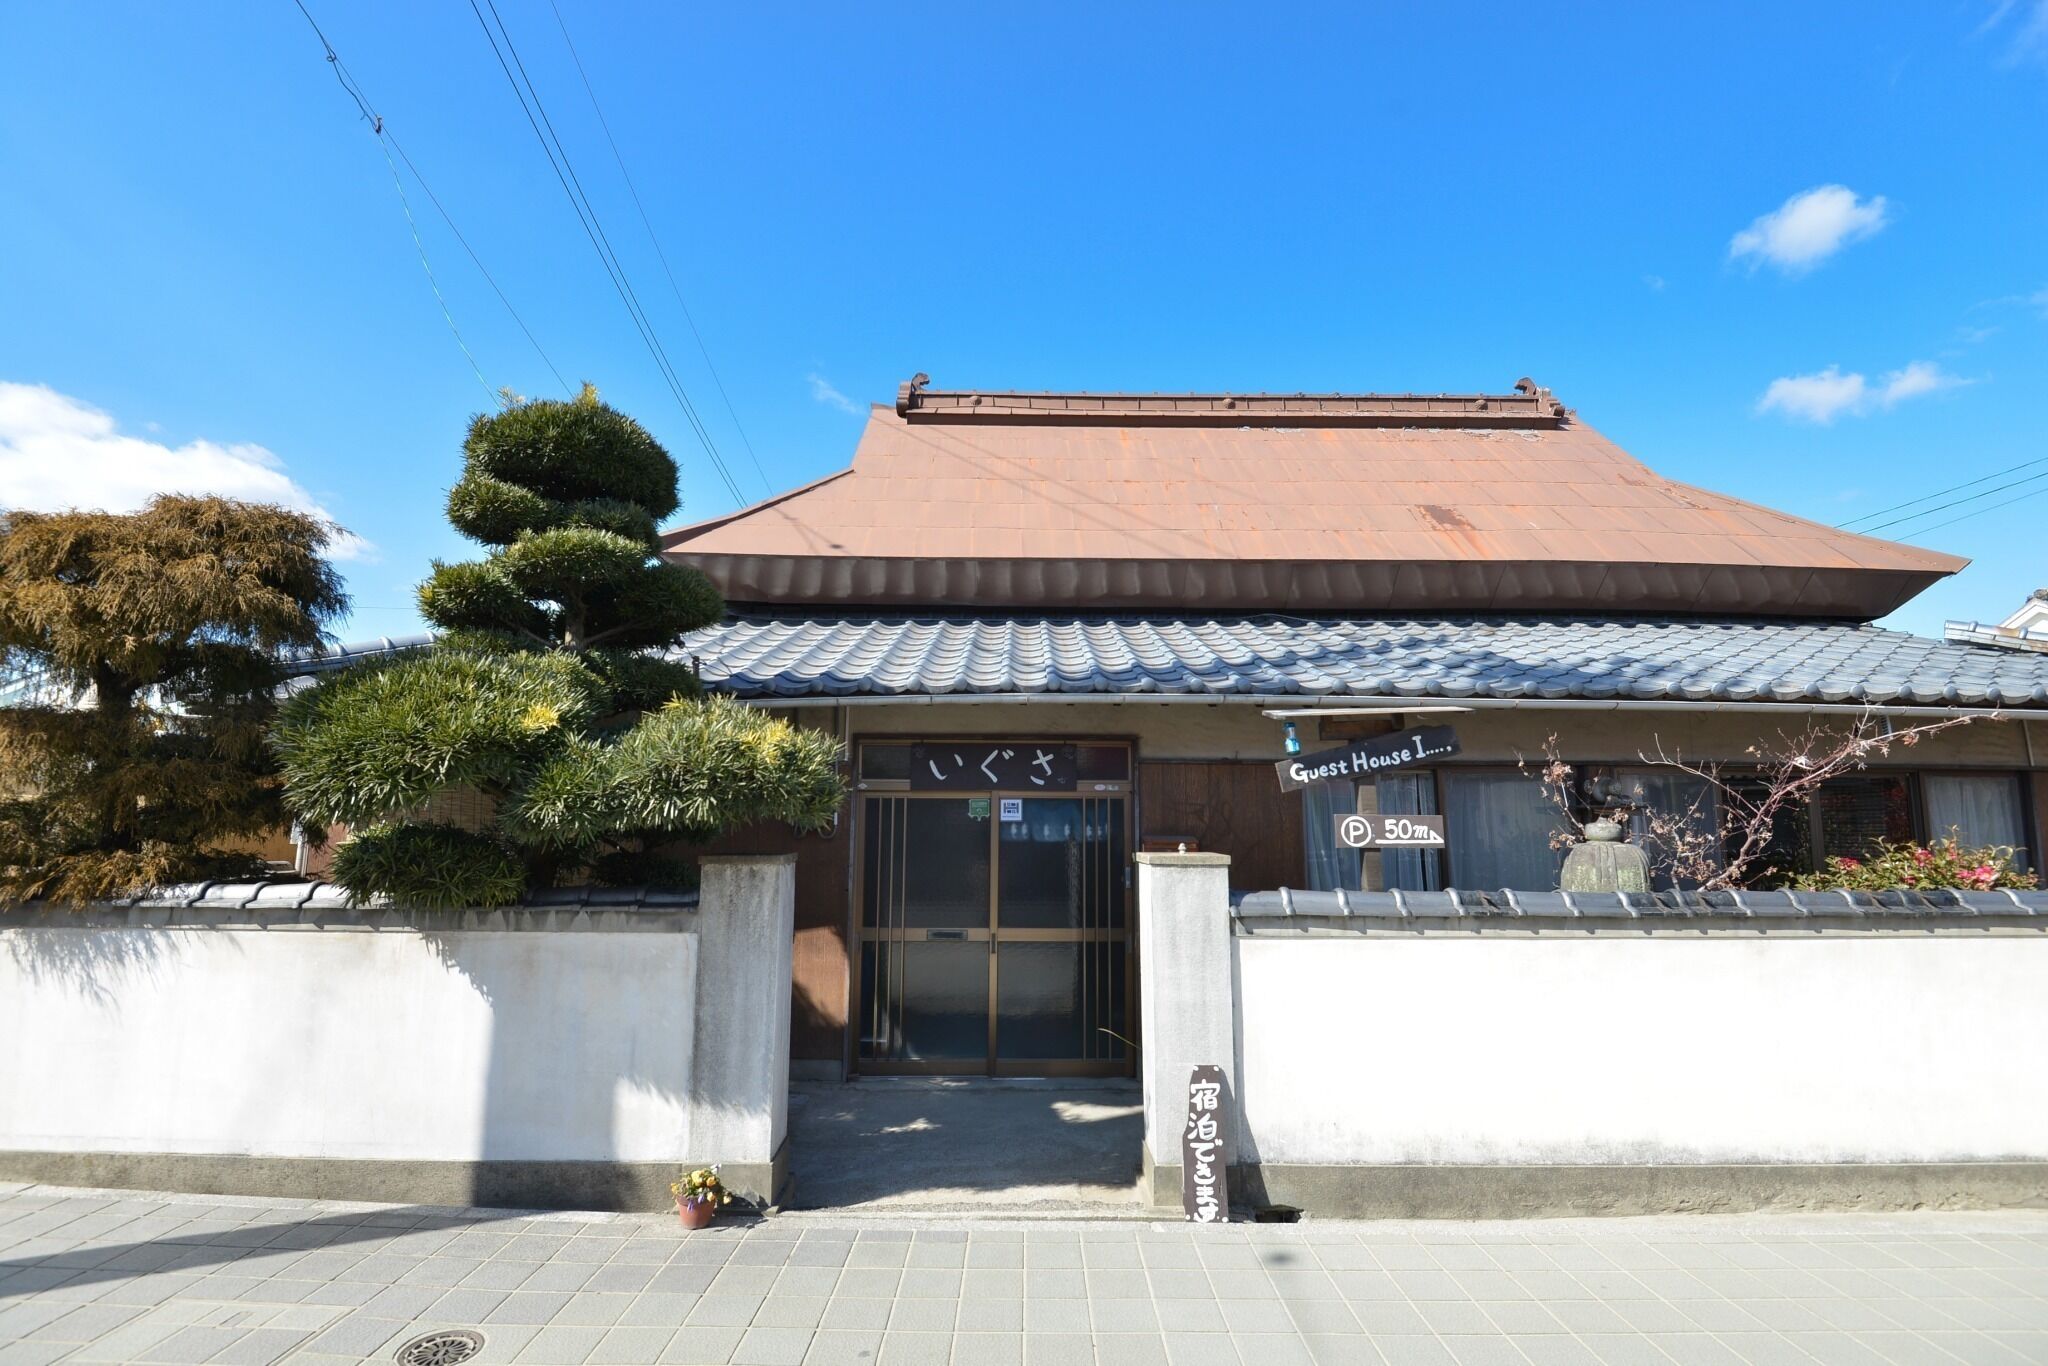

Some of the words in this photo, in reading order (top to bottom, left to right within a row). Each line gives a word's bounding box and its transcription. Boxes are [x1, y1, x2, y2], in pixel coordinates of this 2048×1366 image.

[929, 749, 1055, 786] いぐさ
[1289, 760, 1349, 783] Guest
[1352, 748, 1412, 773] House
[1384, 818, 1428, 840] 50m
[1187, 1079, 1223, 1223] 宿泊できます
